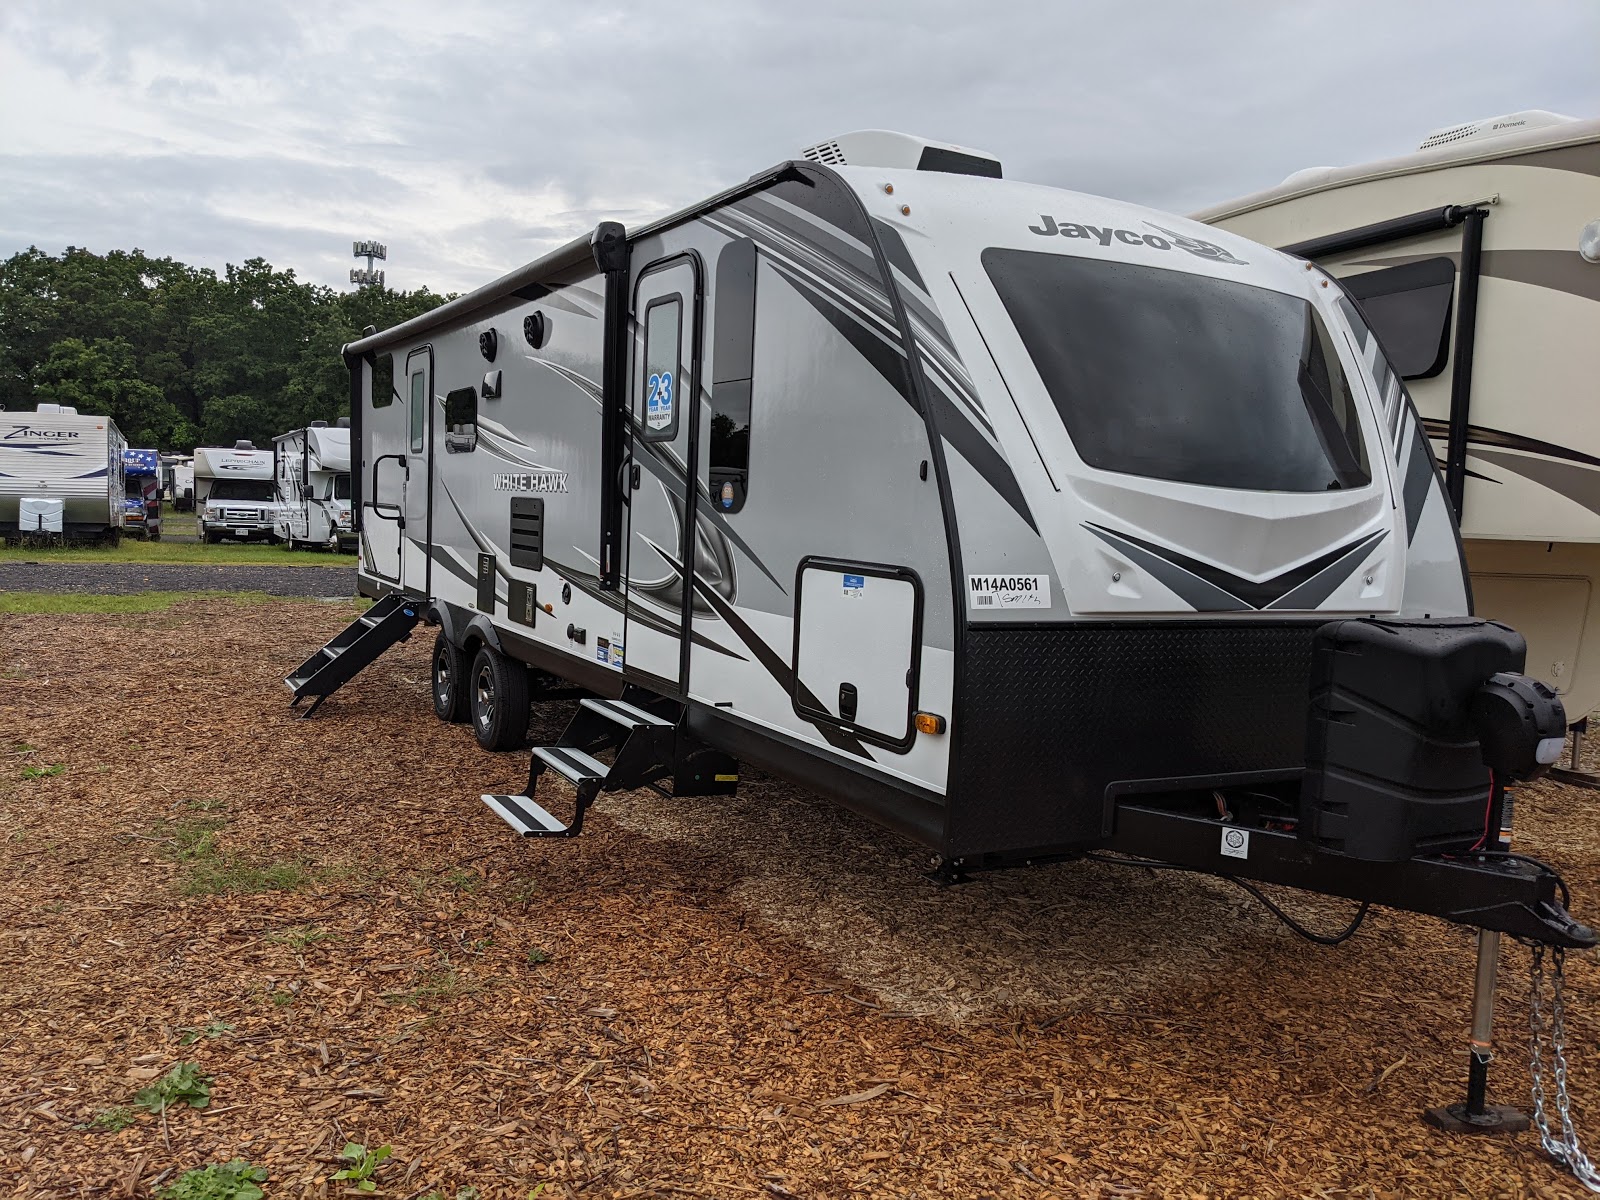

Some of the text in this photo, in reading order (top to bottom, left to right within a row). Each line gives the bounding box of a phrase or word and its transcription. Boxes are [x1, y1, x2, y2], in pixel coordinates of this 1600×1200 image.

[1028, 214, 1172, 250] Jayco
[3, 425, 79, 439] ZINGER
[493, 473, 568, 493] WHITE HAWK
[971, 577, 1038, 591] M14A0561
